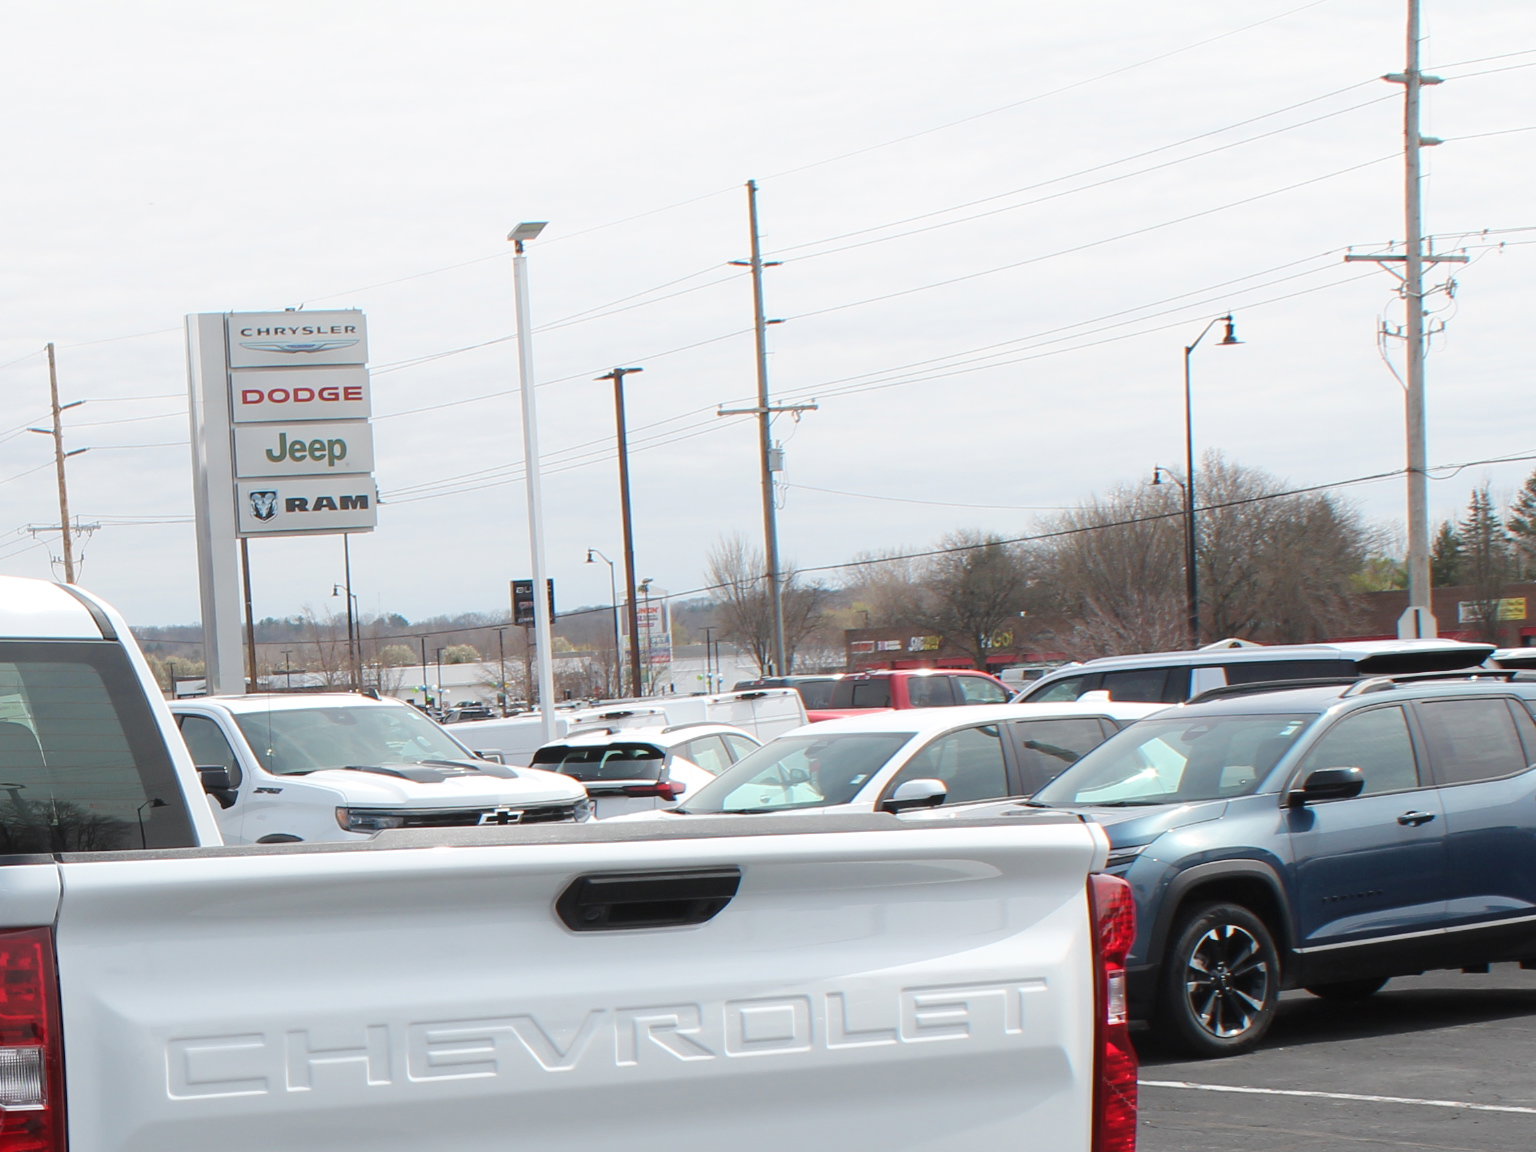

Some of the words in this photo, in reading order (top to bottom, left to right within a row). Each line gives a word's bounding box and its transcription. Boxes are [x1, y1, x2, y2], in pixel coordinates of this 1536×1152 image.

[240, 325, 357, 337] CHRYSLER
[241, 386, 364, 405] DODGE
[265, 432, 348, 467] Jeep
[285, 494, 369, 513] RAM
[165, 976, 1048, 1101] CHEVROLET
